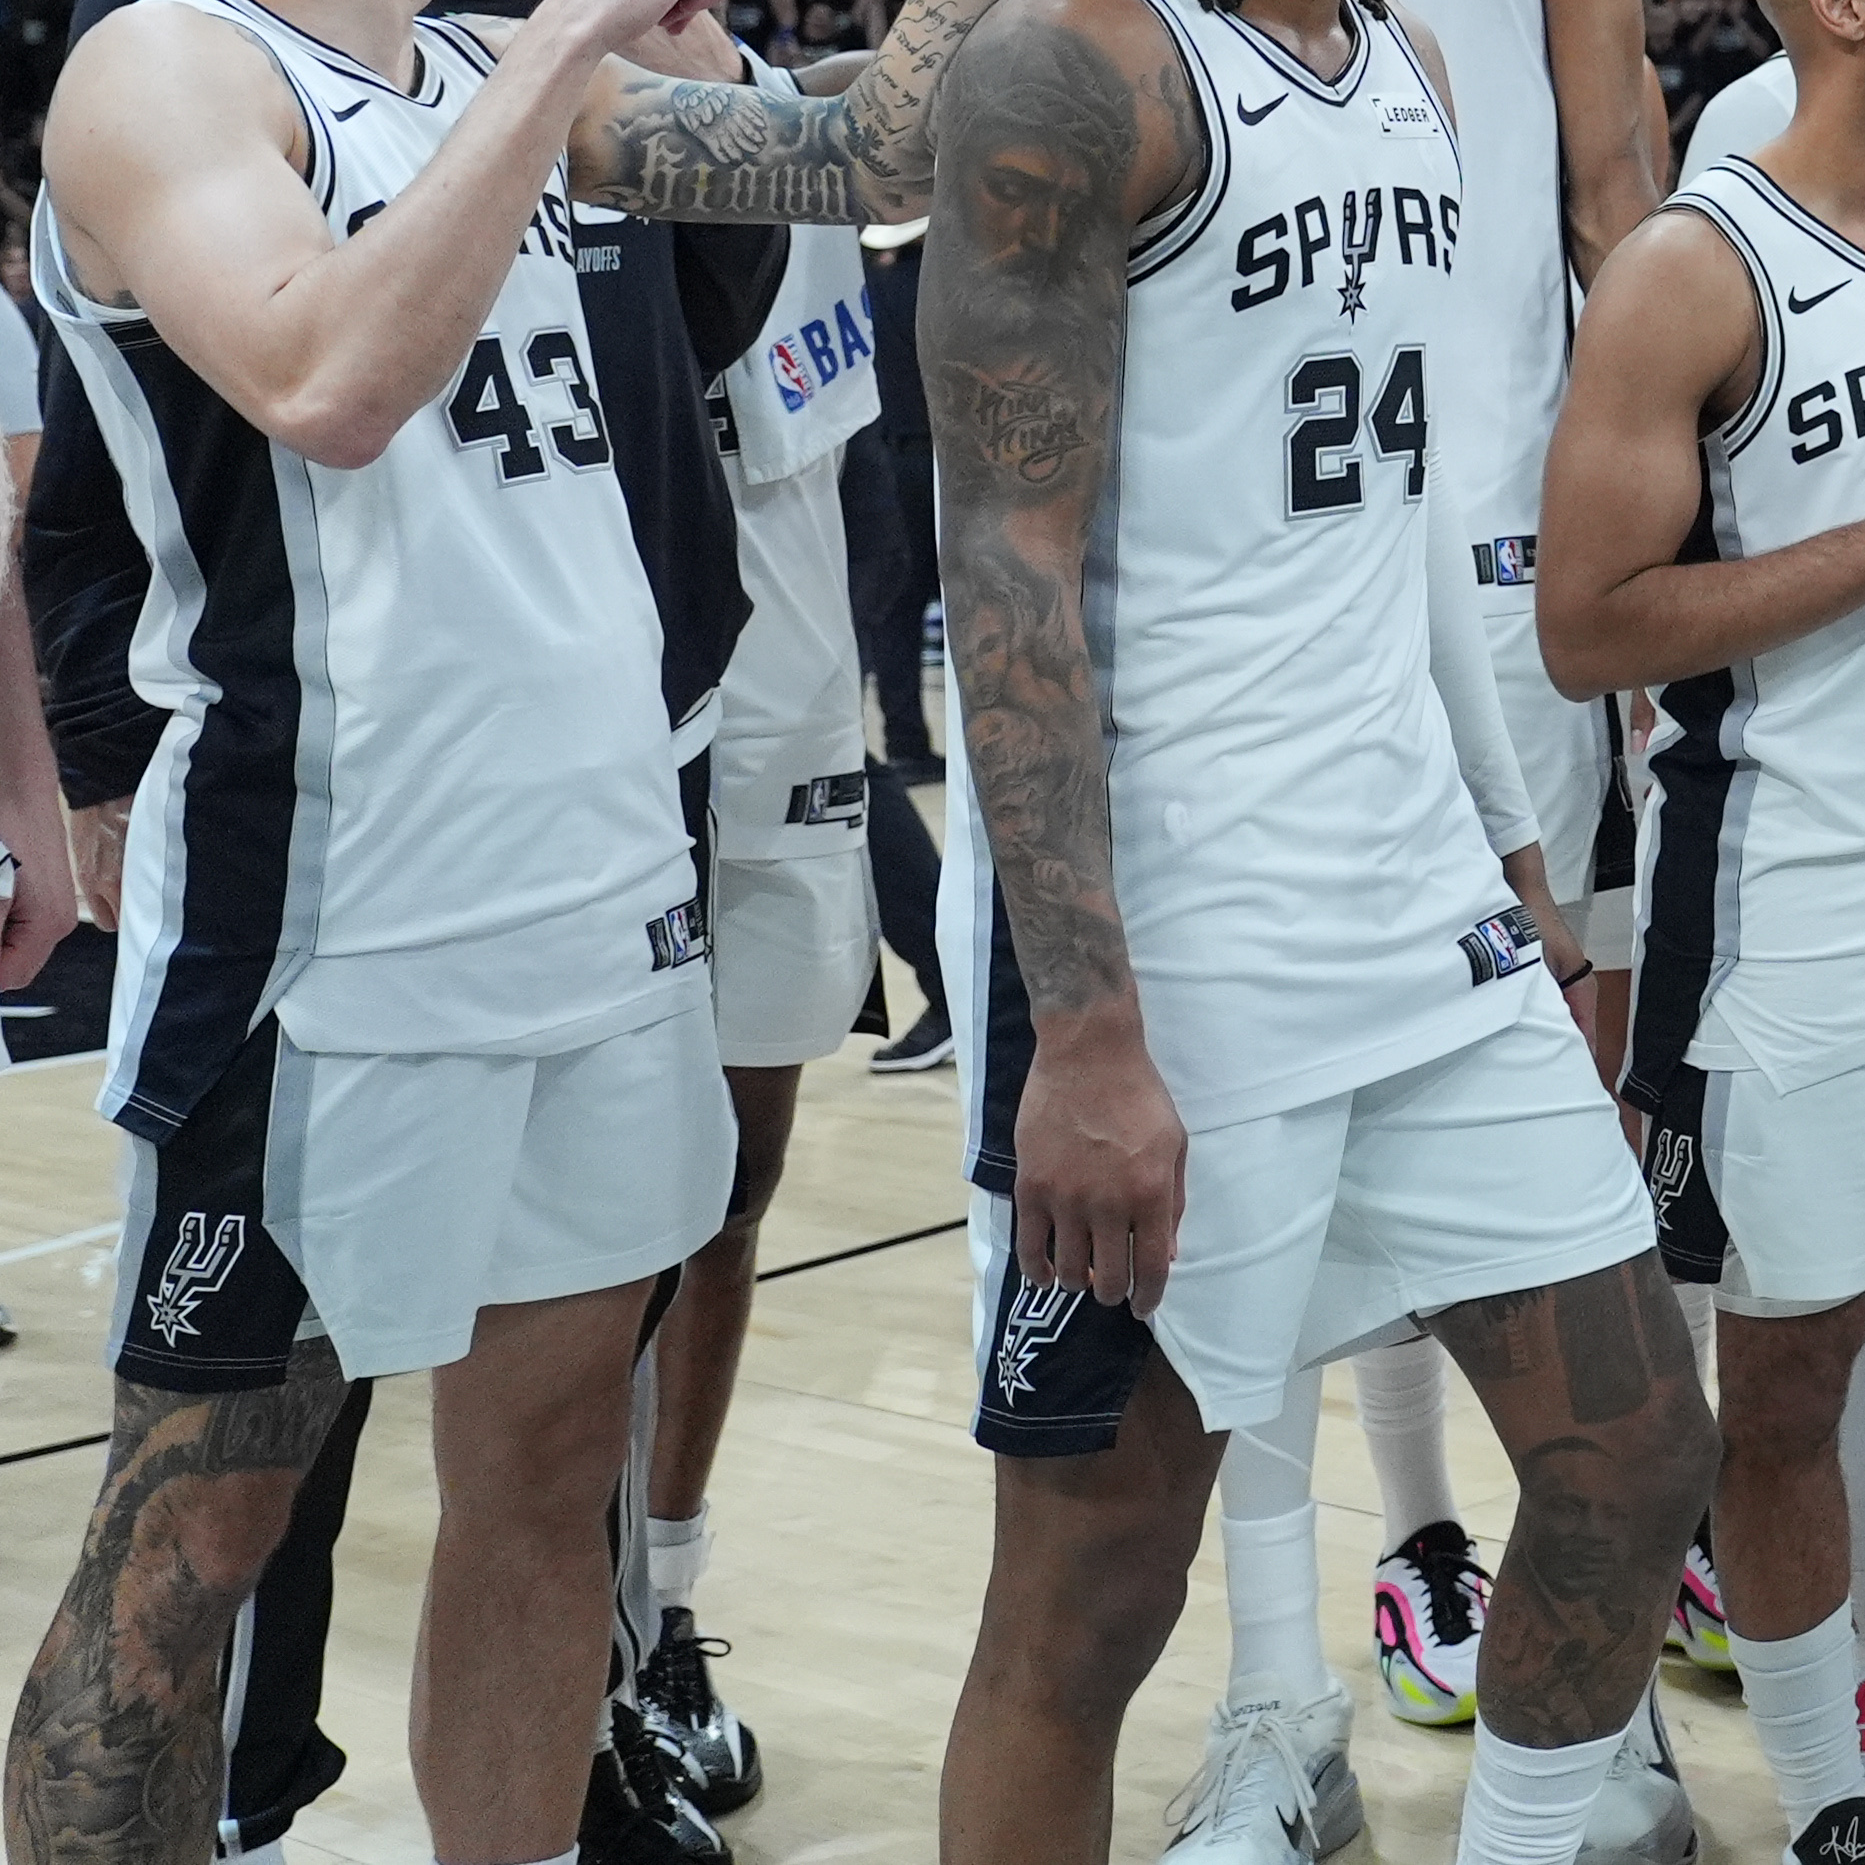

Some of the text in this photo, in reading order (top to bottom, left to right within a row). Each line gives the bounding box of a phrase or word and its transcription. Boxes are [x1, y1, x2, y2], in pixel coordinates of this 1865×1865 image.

[1385, 104, 1430, 124] LEDGER
[575, 245, 621, 274] AYOFFS
[1231, 186, 1461, 324] SPURS
[440, 325, 614, 490] 43
[1284, 343, 1428, 520] 24
